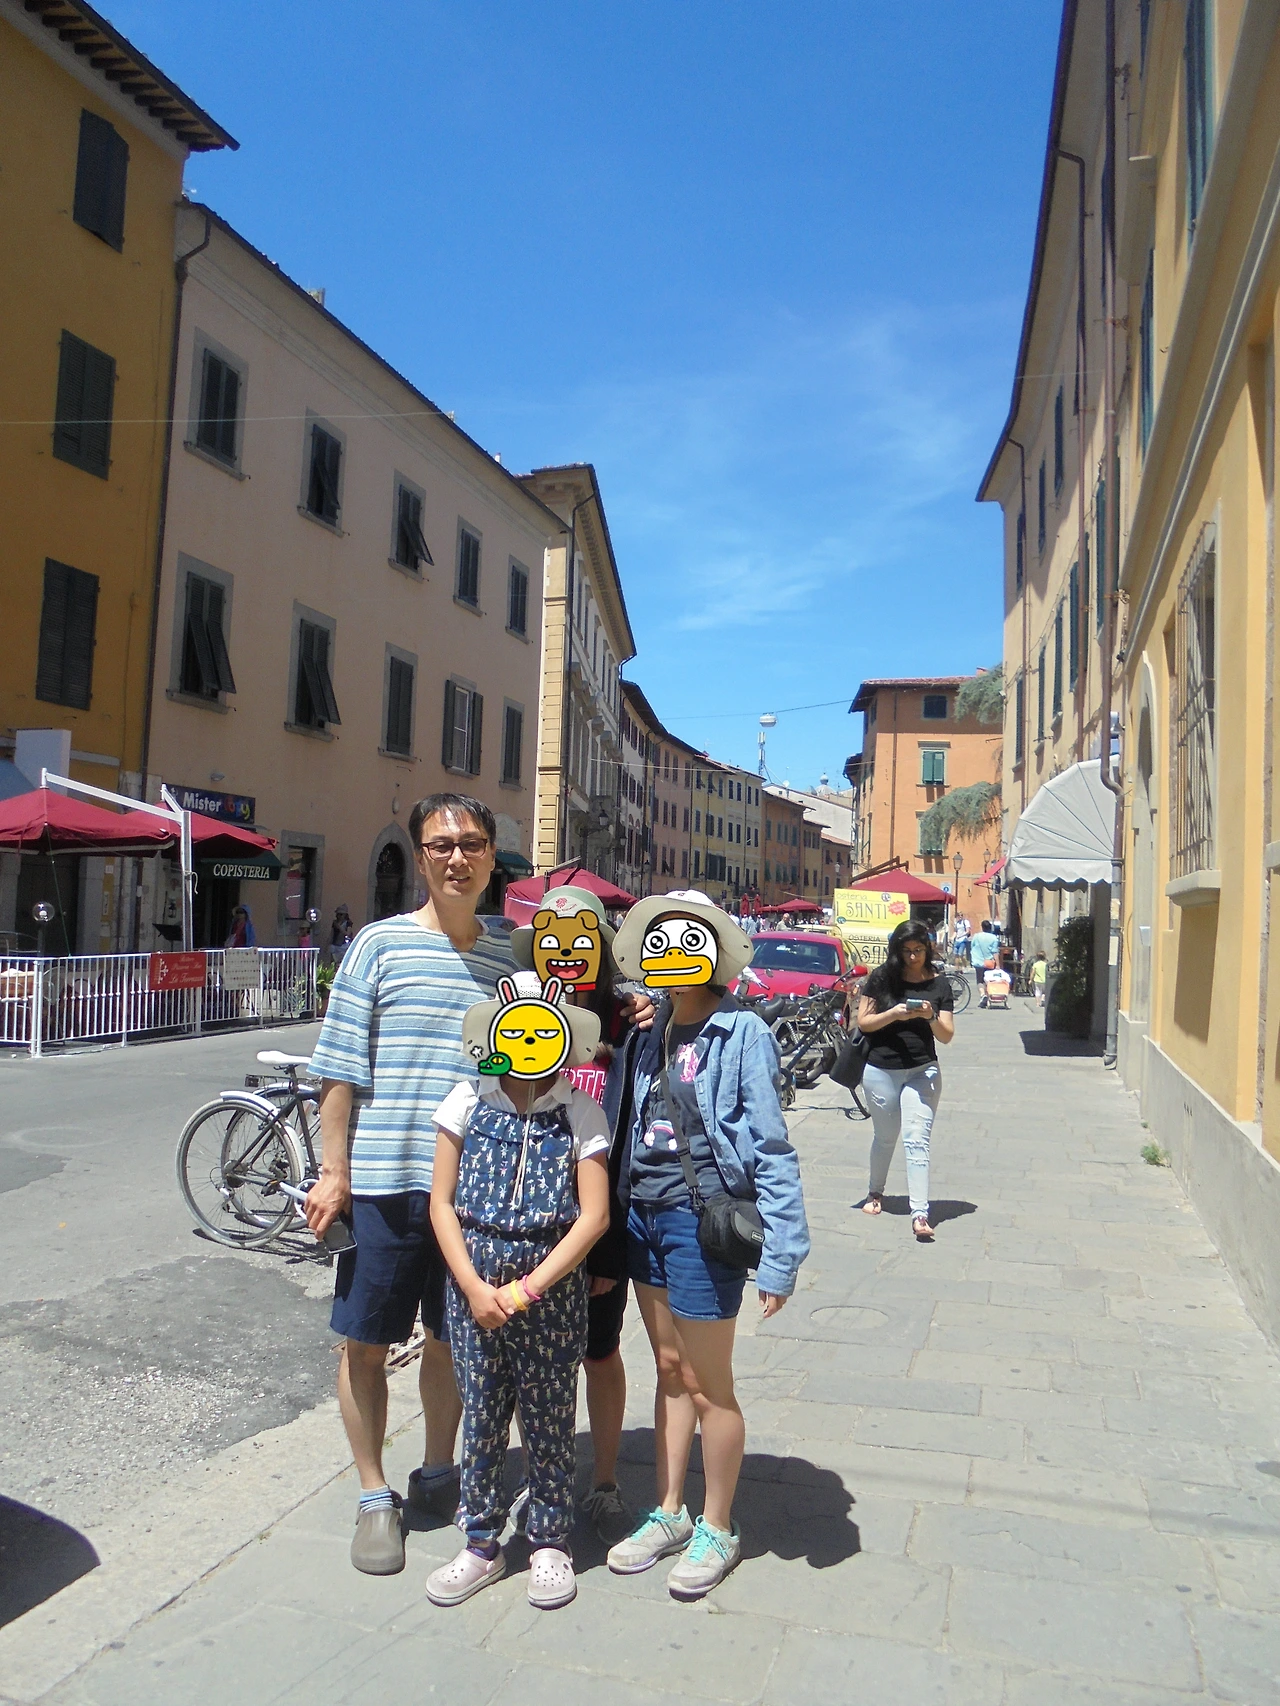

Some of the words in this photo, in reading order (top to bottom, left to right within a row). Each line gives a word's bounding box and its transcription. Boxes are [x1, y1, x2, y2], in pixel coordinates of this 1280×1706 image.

[183, 792, 221, 812] Mister
[213, 863, 270, 878] COPISTERIA
[846, 902, 887, 920] SANTI
[848, 934, 881, 942] OSTERIA
